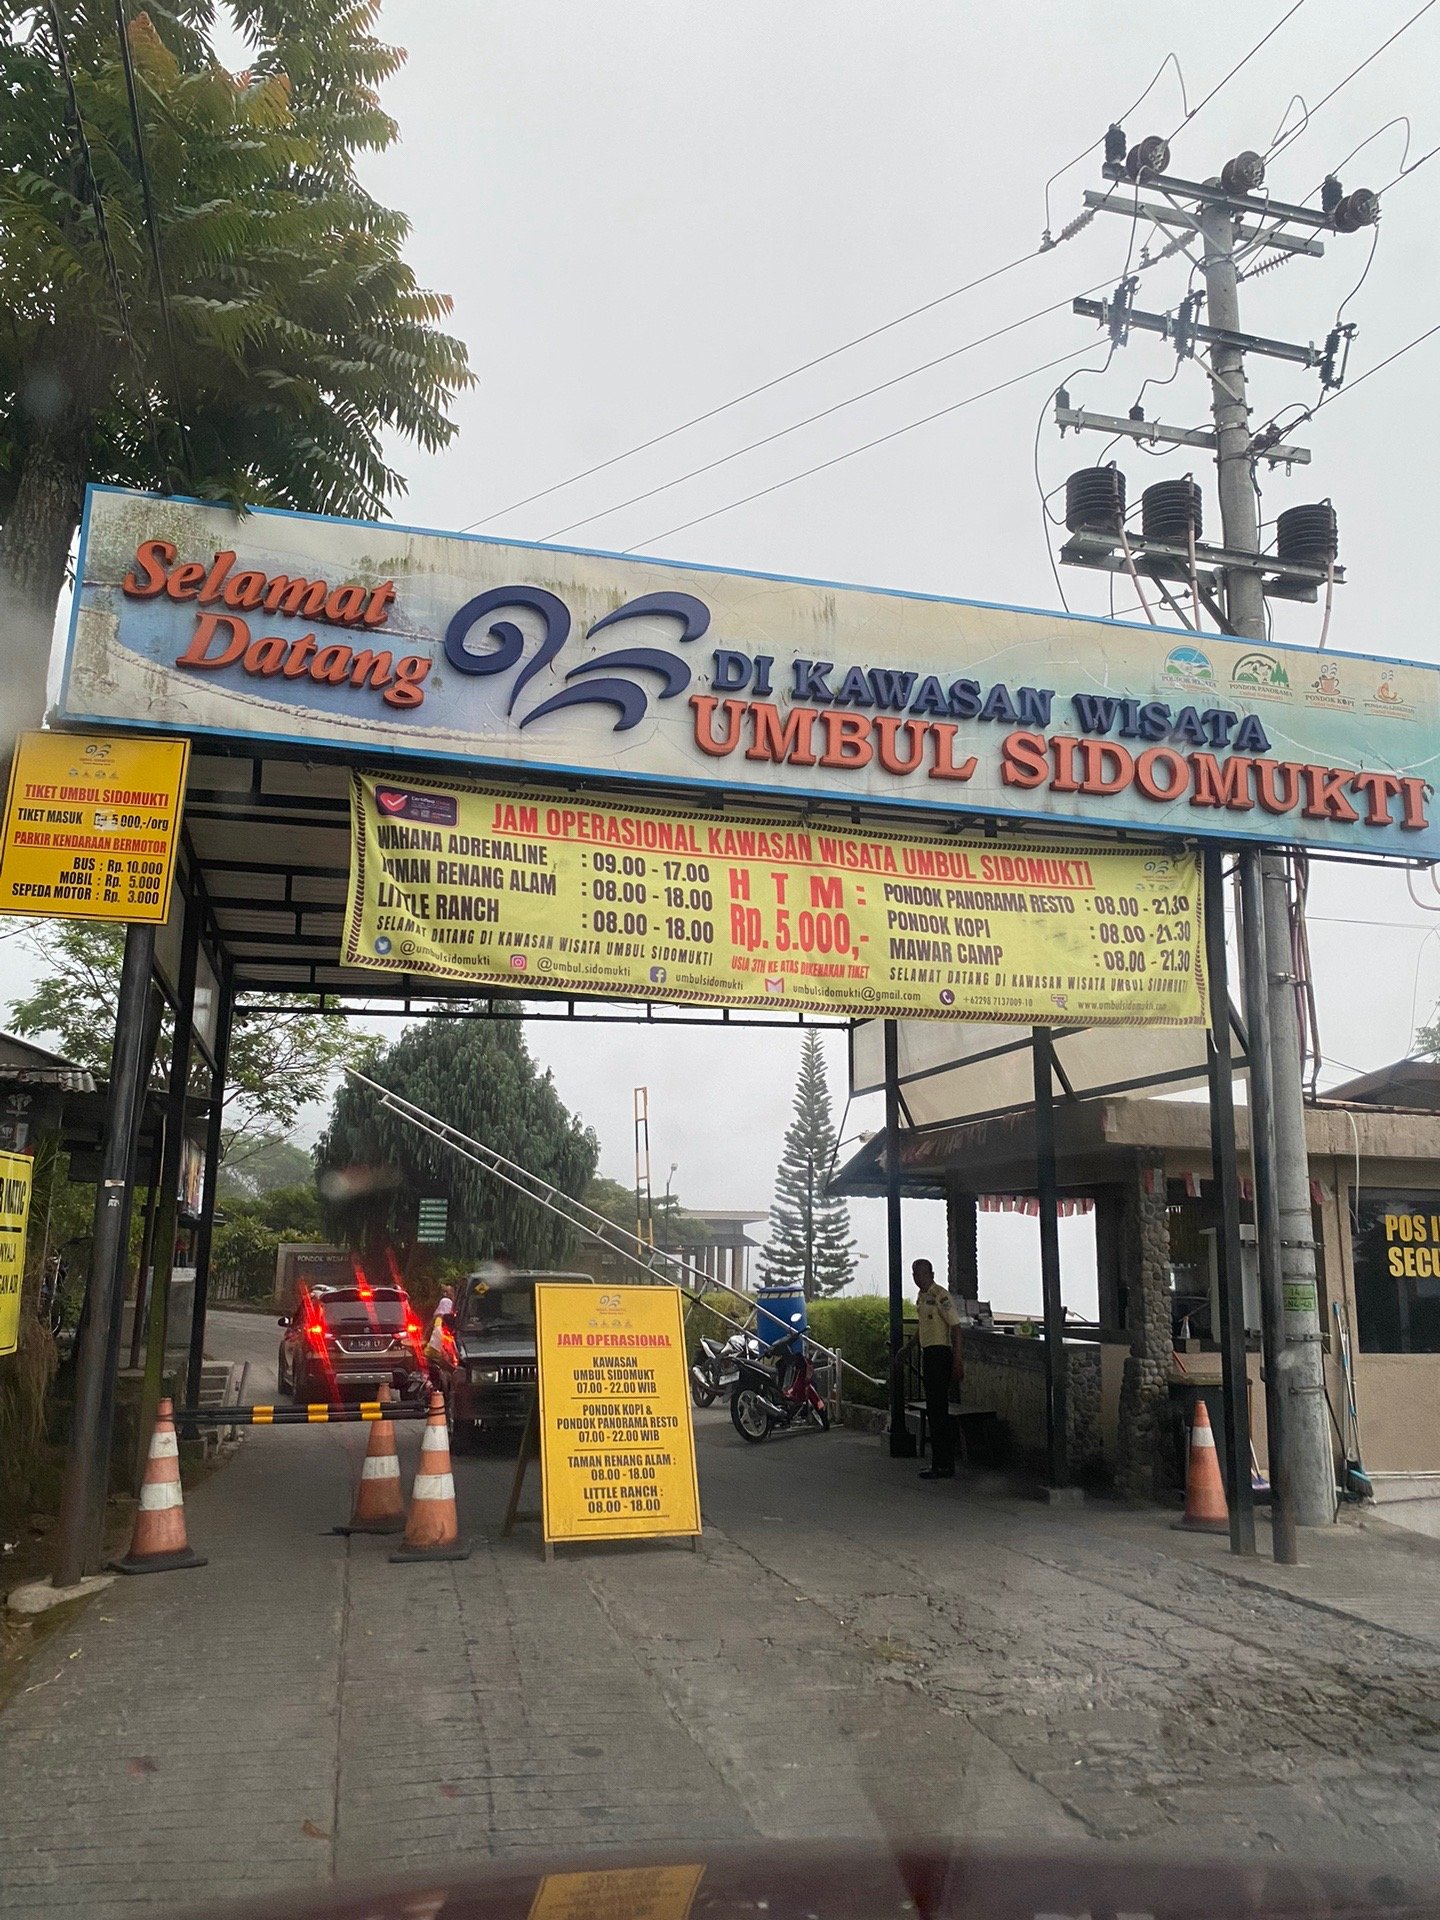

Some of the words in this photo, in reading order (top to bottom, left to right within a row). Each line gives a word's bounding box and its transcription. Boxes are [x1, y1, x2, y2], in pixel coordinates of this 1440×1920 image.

[122, 540, 397, 627] Selamat
[176, 611, 433, 708] Datang
[1229, 683, 1256, 692] PONDOK
[1305, 694, 1336, 703] PONDOK
[712, 648, 774, 696] DI
[791, 660, 1056, 728] KAWASAN
[1071, 695, 1271, 753] WISATA
[689, 695, 979, 781] UMBUL
[1000, 730, 1433, 832] SIDOMUKTI
[25, 784, 57, 799] TIKET
[60, 786, 99, 802] UMBUL
[102, 789, 169, 807] SIDOMUKTI
[18, 807, 45, 822] TIKET
[47, 810, 83, 824] MASUK
[111, 813, 169, 831] 5000,-/org
[14, 831, 51, 846] PARKIR
[53, 833, 111, 850] KENDARAAN
[113, 837, 166, 854] BERMOTOR
[377, 825, 443, 853] WAHANA
[448, 834, 548, 866] ADRENALINE
[492, 803, 538, 834] JAM
[546, 806, 702, 853] OPERASIONAL
[707, 827, 812, 862] KAWASAN
[818, 836, 897, 874] WISATA
[902, 847, 977, 880] UMBUL
[980, 853, 1094, 886] SIDOMUKTI
[73, 857, 96, 871] BUS
[107, 859, 124, 873] Rp.
[127, 860, 163, 875] 10.000
[593, 852, 646, 877] 09.00
[663, 860, 710, 883] 17.00
[59, 871, 93, 886] MOBIL
[105, 875, 121, 889] Rp.
[129, 875, 160, 890] 5.000
[437, 861, 504, 890] RENANG
[509, 869, 556, 896] ALAM
[729, 868, 751, 901] H
[771, 872, 788, 904] T
[810, 876, 844, 909] M
[12, 883, 51, 898] SEPEDA
[53, 886, 91, 900] MOTOR
[103, 889, 120, 903] Rp.
[127, 890, 159, 904] 3.000
[593, 879, 647, 904] 08.00
[664, 886, 713, 912] 18.00
[884, 883, 944, 908] PONDOK
[947, 889, 1028, 914] PANORAMA
[1031, 894, 1075, 914] RESTO
[1095, 895, 1138, 916] 08.00
[436, 893, 499, 923] RANCH
[593, 909, 647, 936] 08.00
[665, 916, 714, 944] 18.00
[730, 903, 768, 951] Rp.
[776, 909, 869, 960] 5.000,-
[888, 909, 950, 936] PONDOK
[955, 917, 991, 939] KOPI
[1100, 923, 1145, 944] 08.00
[1156, 921, 1190, 944] 21.30
[376, 915, 427, 937] SELAMAT
[431, 928, 474, 945] DATANG
[480, 930, 493, 946] DI
[499, 931, 553, 950] KAWASAN
[559, 936, 600, 955] WISATA
[606, 942, 645, 959] UMBUL
[651, 945, 713, 966] SIDOMUKTI
[890, 938, 952, 963] MAWAR
[957, 943, 1003, 966] CAMP
[1104, 950, 1146, 972] 08.00
[1161, 950, 1190, 972] 21.30
[537, 956, 631, 978] @umbul.sidomukti
[731, 955, 750, 971] USIA
[752, 957, 766, 972] 3TH
[768, 960, 778, 973] KE
[780, 961, 799, 975] ATAS
[801, 963, 844, 979] DIKENAKAN
[847, 965, 869, 979] TIKET
[675, 972, 744, 990] umbulsidomukti
[889, 967, 941, 984] SELAMAT
[948, 970, 989, 986] DATANG
[996, 972, 1006, 987] DI
[1012, 974, 1062, 990] KAWASAN
[1068, 976, 1106, 991] WISATA
[1111, 978, 1143, 992] UMBUL
[793, 983, 921, 1002] umbulsidomukti@gmail.com
[1384, 1214, 1427, 1242] POS
[1431, 1216, 1440, 1242] I
[557, 1333, 582, 1346] JAM
[587, 1334, 671, 1347] OPERASIONAL
[592, 1356, 637, 1368] KAWASAN
[573, 1369, 605, 1381] UMBUL
[577, 1382, 601, 1393] 07.00
[610, 1382, 635, 1393] 22.00
[637, 1382, 656, 1393] WIB
[583, 1404, 620, 1416] PONDOK
[622, 1404, 643, 1416] KOPI
[646, 1406, 652, 1415] &
[557, 1418, 595, 1430] PONDOK
[597, 1416, 648, 1429] PANORAMA
[650, 1416, 678, 1428] RESTO
[578, 1430, 604, 1442] 07.00
[612, 1430, 638, 1442] 22.00
[640, 1429, 659, 1441] WIB
[567, 1455, 601, 1467] TAMAN
[604, 1455, 642, 1467] RENANG
[645, 1454, 671, 1466] ALAM
[591, 1468, 620, 1481] 08.00
[629, 1467, 655, 1479] 18.00
[583, 1487, 617, 1499] LITTLE
[620, 1485, 658, 1498] RANCH
[588, 1501, 621, 1513] 08.00
[630, 1499, 660, 1511] 18.00
